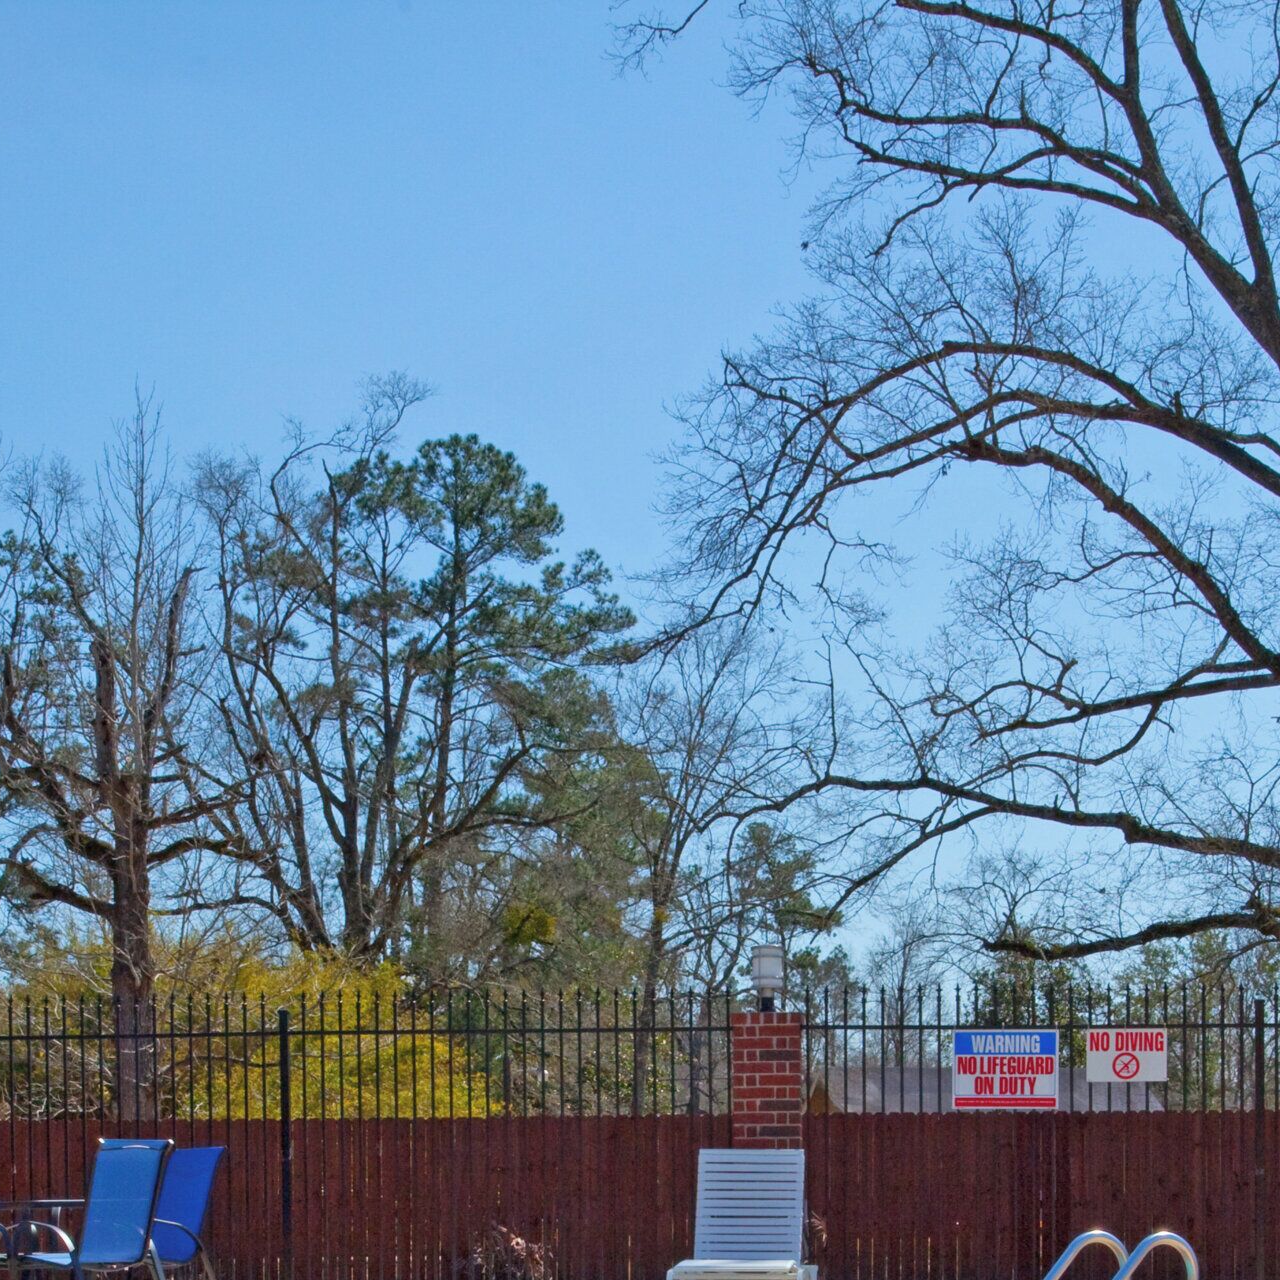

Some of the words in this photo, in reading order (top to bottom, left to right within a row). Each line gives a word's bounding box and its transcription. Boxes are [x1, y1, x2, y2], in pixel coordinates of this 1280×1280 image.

[971, 1034, 1041, 1054] WARNING
[1089, 1031, 1110, 1052] NO
[1115, 1031, 1164, 1051] DIVING
[957, 1056, 977, 1075] NO
[980, 1056, 1054, 1075] LIFEGUARD
[974, 1076, 995, 1095] ON
[999, 1076, 1037, 1095] DUTY
